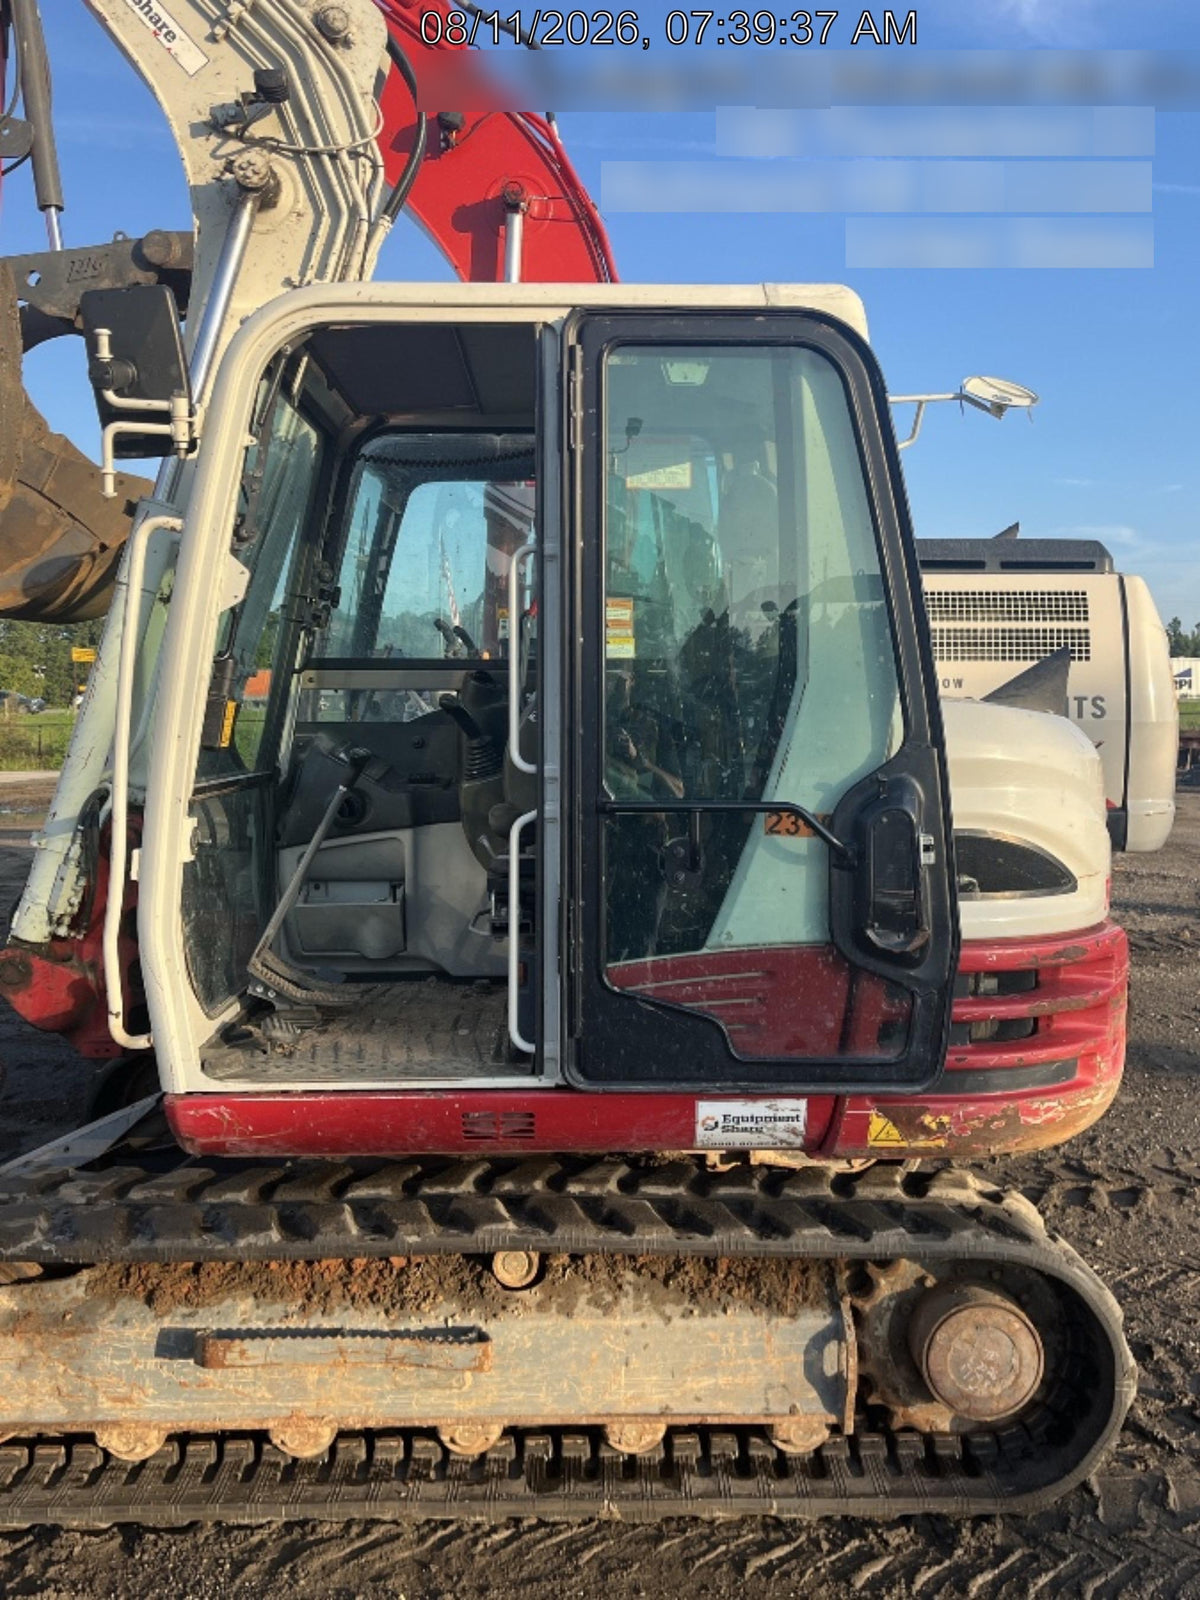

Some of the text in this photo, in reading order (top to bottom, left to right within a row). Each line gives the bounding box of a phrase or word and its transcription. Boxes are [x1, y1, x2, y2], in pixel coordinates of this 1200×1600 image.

[936, 678, 963, 689] OW
[1065, 696, 1107, 719] TS
[721, 1113, 801, 1125] Equipment
